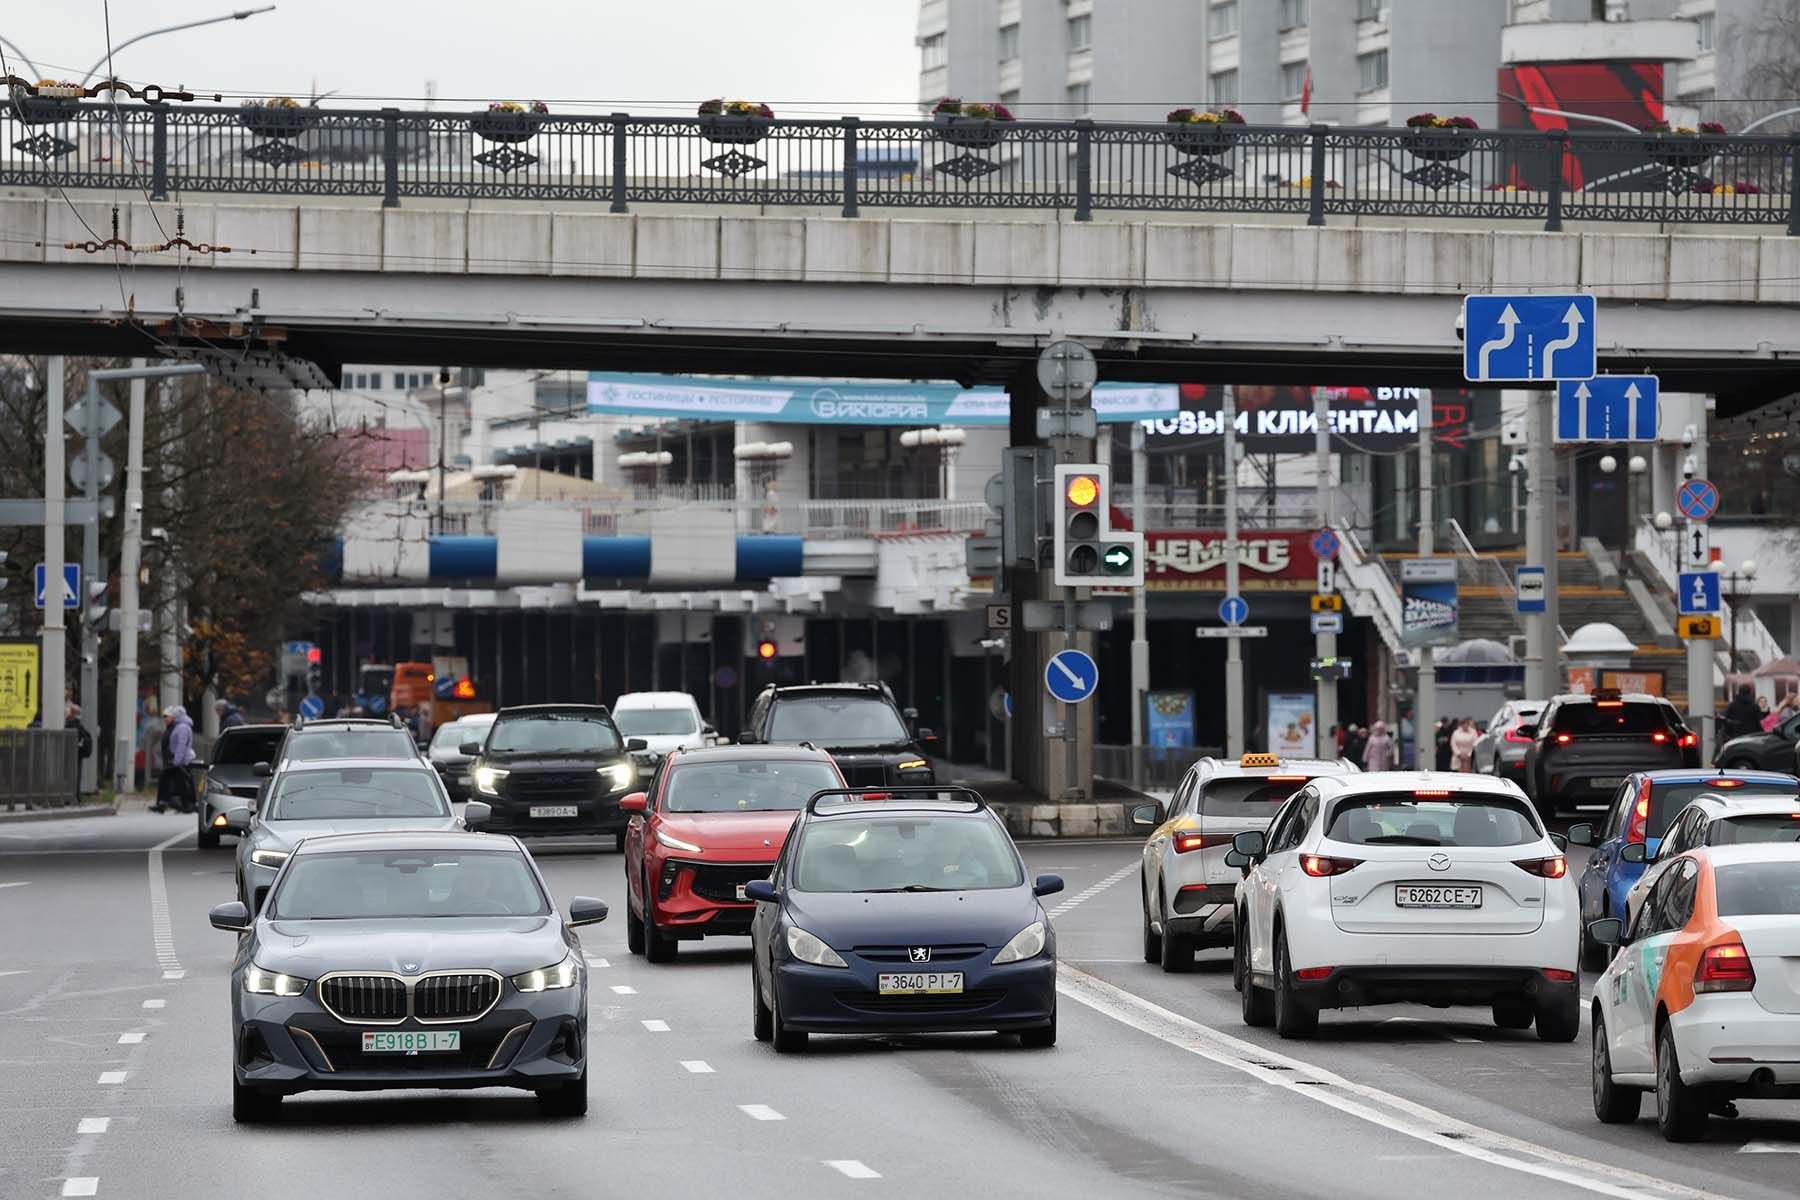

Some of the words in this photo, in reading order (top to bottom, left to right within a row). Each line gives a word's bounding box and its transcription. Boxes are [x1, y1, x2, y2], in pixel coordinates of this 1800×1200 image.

[1257, 410, 1418, 434] КЛИЕНТАМ
[996, 608, 1008, 625] S
[1409, 889, 1441, 903] 6262
[1443, 889, 1479, 903] CE-7
[892, 975, 923, 989] 3640
[928, 974, 961, 988] PI-7
[365, 1042, 373, 1050] BY
